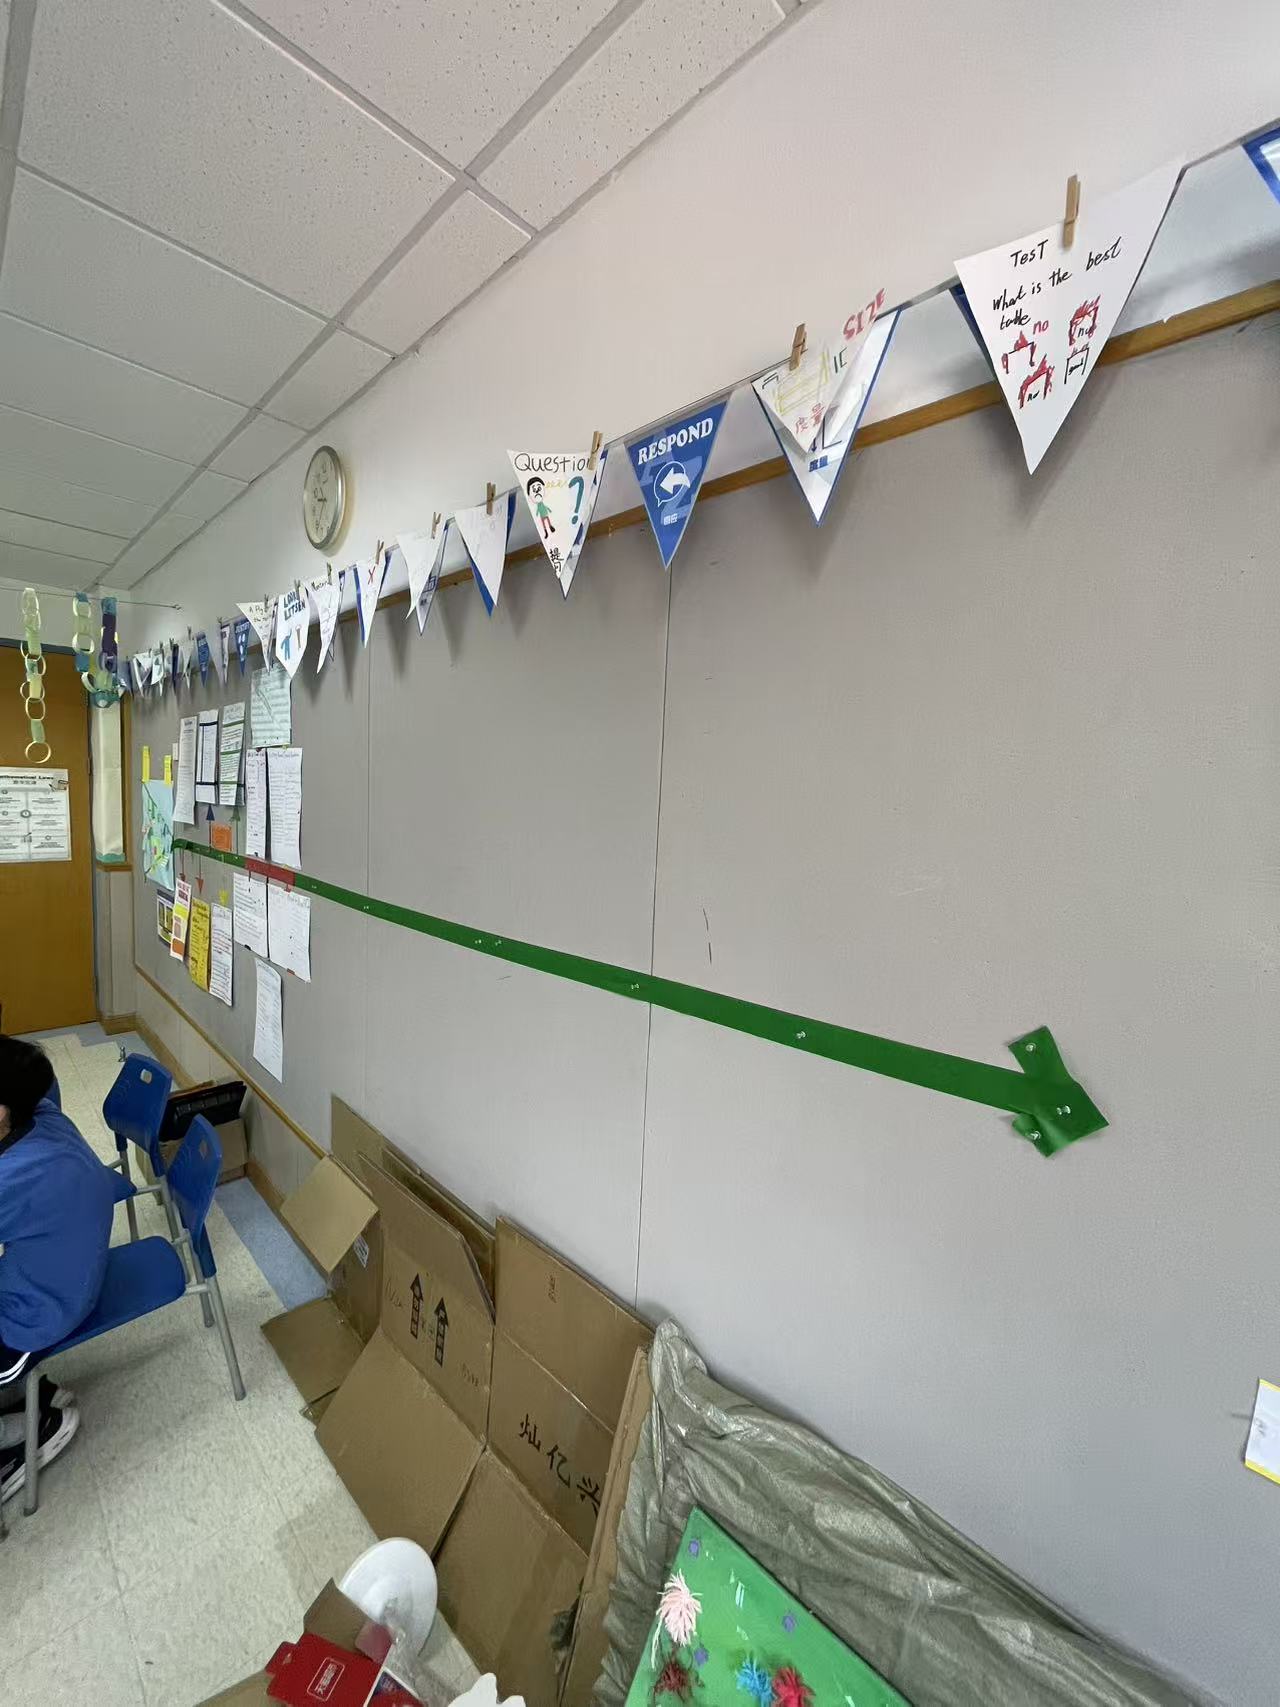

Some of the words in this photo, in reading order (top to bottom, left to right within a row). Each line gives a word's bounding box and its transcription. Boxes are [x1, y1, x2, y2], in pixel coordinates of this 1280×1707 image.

[993, 285, 1027, 311] What
[1032, 282, 1042, 294] is
[1049, 268, 1072, 287] the
[1086, 236, 1121, 271] best
[1033, 320, 1049, 335] no
[638, 417, 713, 465] RESPOND
